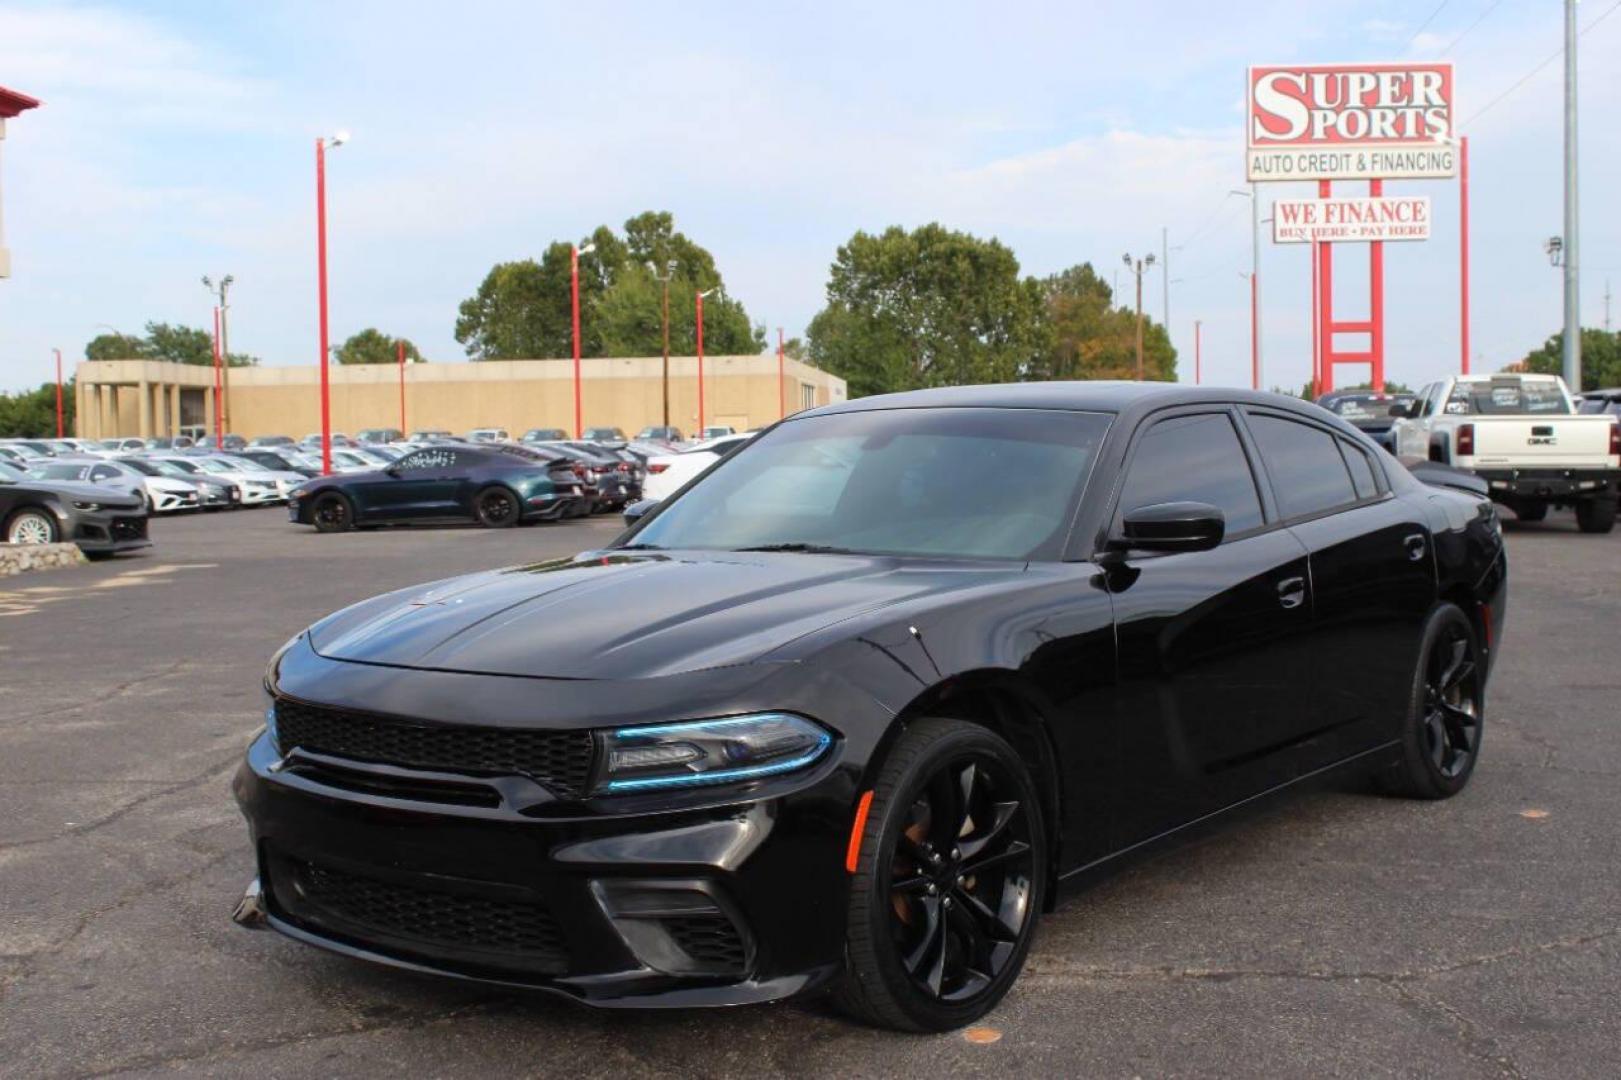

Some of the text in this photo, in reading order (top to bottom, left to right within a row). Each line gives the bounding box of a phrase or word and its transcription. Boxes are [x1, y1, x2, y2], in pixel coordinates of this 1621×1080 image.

[1254, 71, 1447, 140] SUPER
[1253, 151, 1452, 173] AUTO CREDIT & FINANCING
[1280, 201, 1426, 224] WE FINANCE
[1280, 225, 1426, 237] BUY HERE PAY HERE
